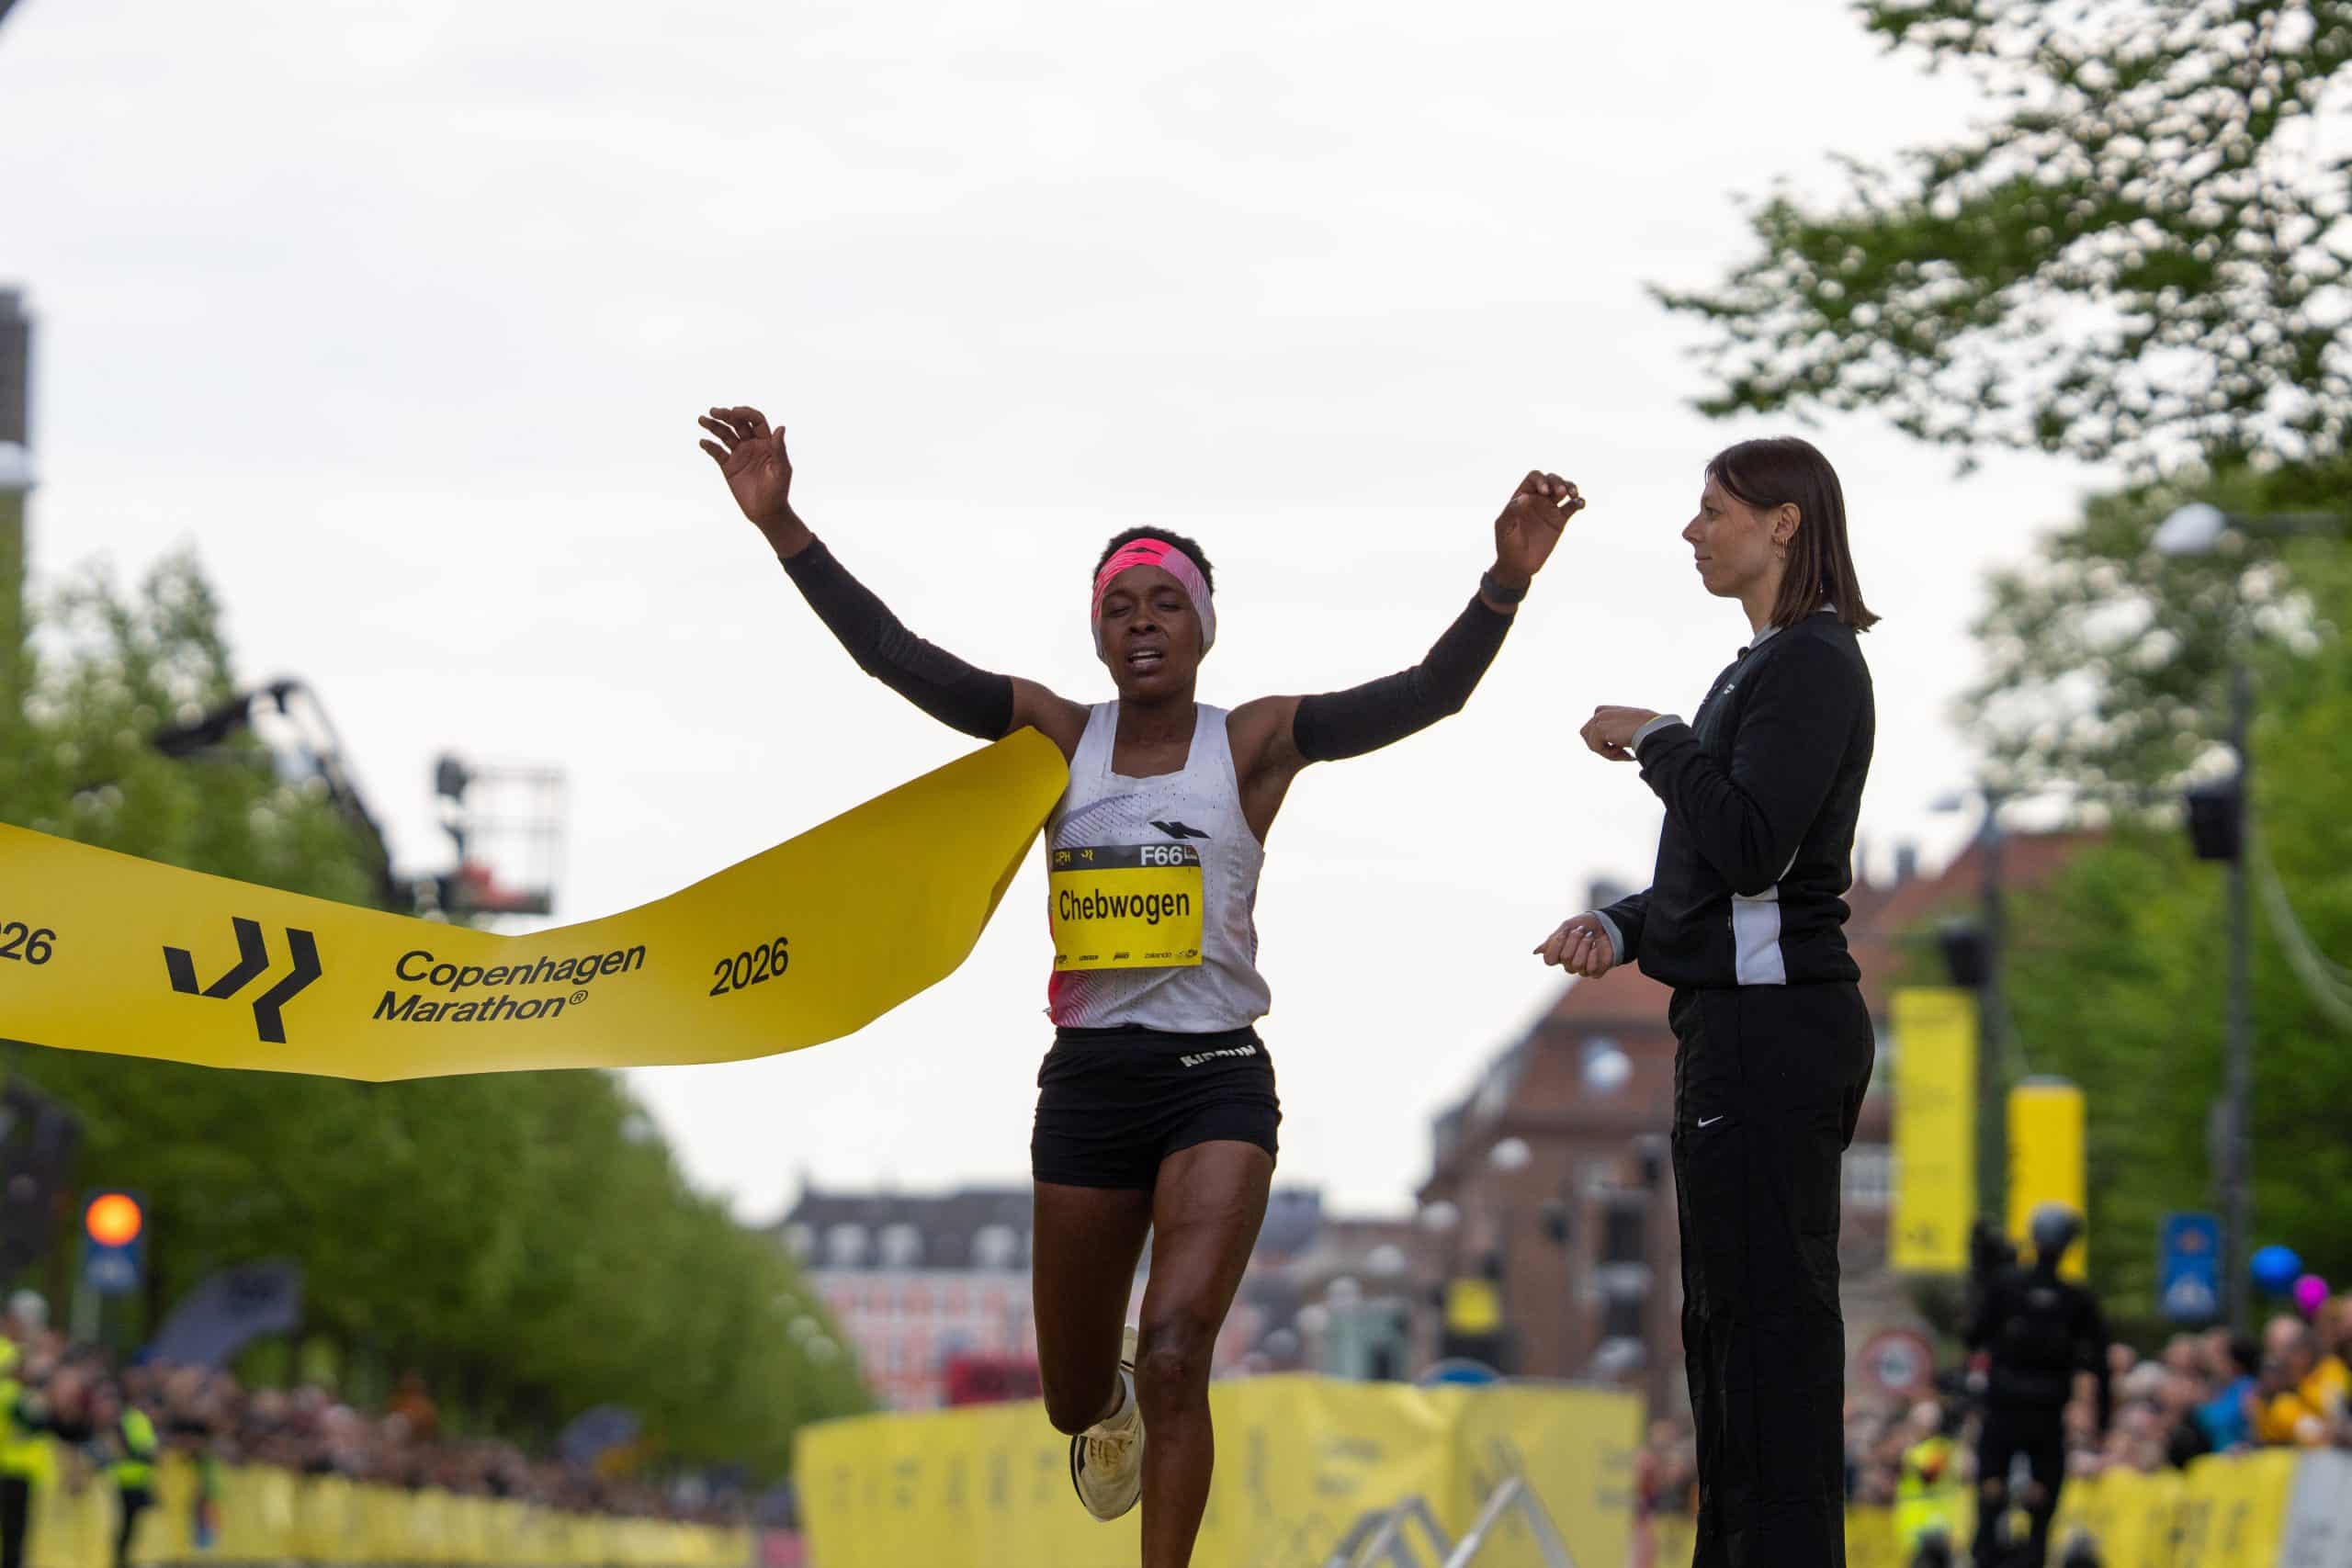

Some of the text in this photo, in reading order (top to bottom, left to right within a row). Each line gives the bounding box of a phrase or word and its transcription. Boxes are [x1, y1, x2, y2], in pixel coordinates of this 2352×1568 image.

[1140, 846, 1182, 865] F66
[1059, 888, 1190, 925] Chebwogen
[0, 921, 57, 965] 26
[395, 945, 646, 992] Copenhagen
[709, 936, 789, 997] 2026
